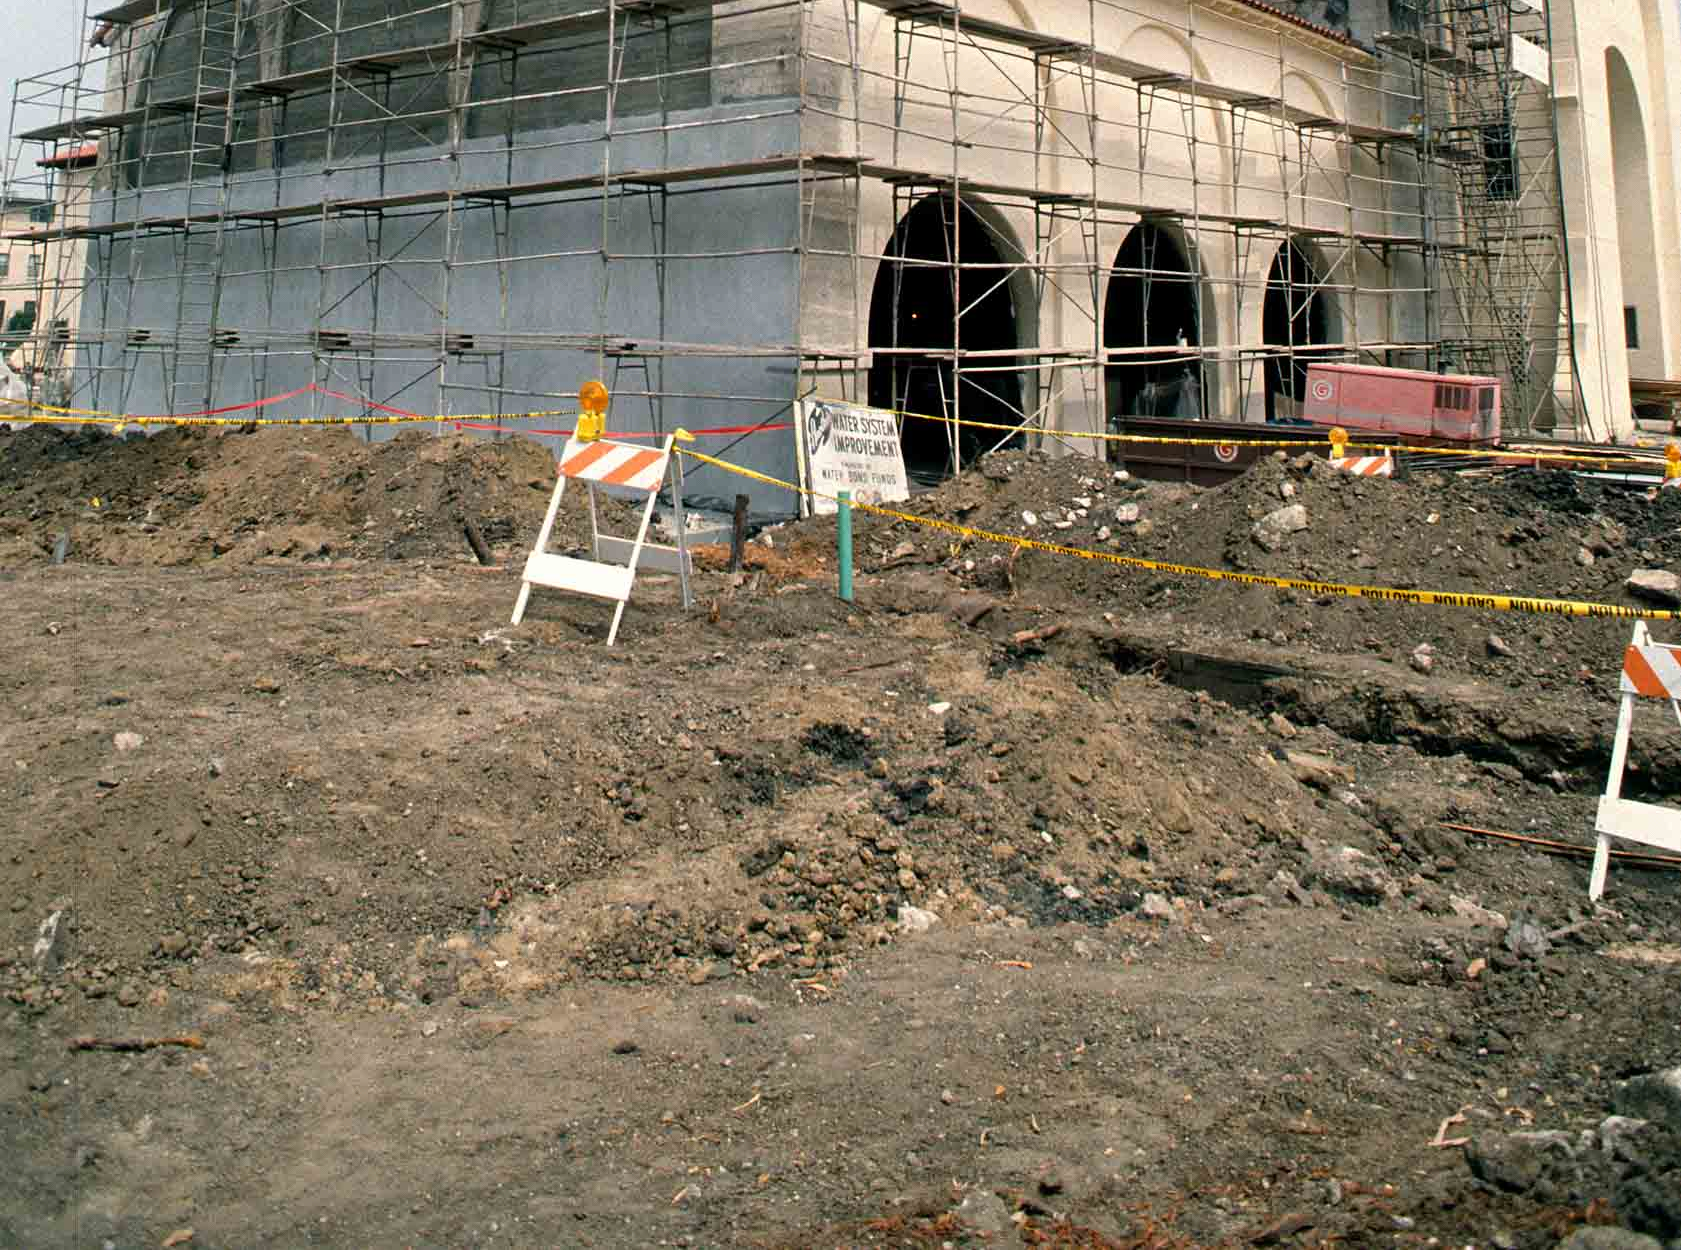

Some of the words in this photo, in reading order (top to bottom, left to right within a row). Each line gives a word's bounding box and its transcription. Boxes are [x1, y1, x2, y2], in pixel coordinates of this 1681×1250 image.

[832, 413, 859, 432] WATER
[861, 418, 896, 436] SYSTEM
[834, 436, 899, 457] IMPROVEMENT
